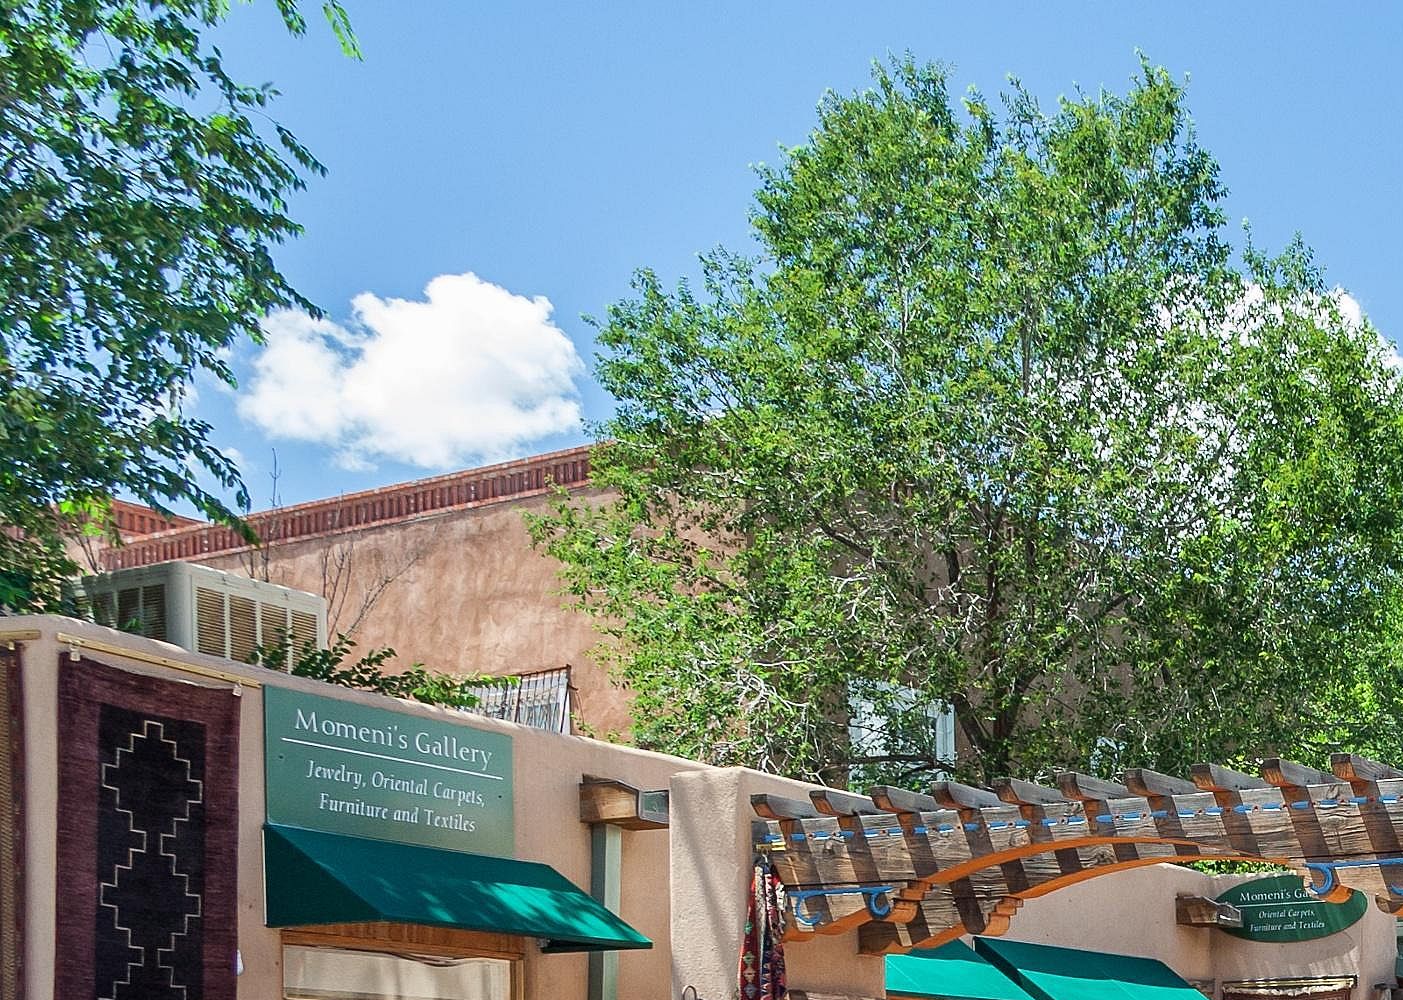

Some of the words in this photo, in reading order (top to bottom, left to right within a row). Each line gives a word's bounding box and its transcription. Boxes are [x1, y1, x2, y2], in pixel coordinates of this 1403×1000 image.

[294, 708, 408, 750] Momeni's
[415, 733, 493, 770] Gallery
[306, 760, 366, 789] Jewelry,
[372, 772, 427, 796] Oriental
[433, 782, 485, 807] Carpets,
[319, 793, 388, 820] Furniture
[393, 807, 418, 824] and
[424, 809, 476, 832] Textiles
[1240, 889, 1291, 901] Momeni's
[1258, 909, 1286, 918] Oriental
[1250, 924, 1281, 932] Furniture
[1283, 921, 1296, 930] and
[1299, 921, 1325, 929] Textiles
